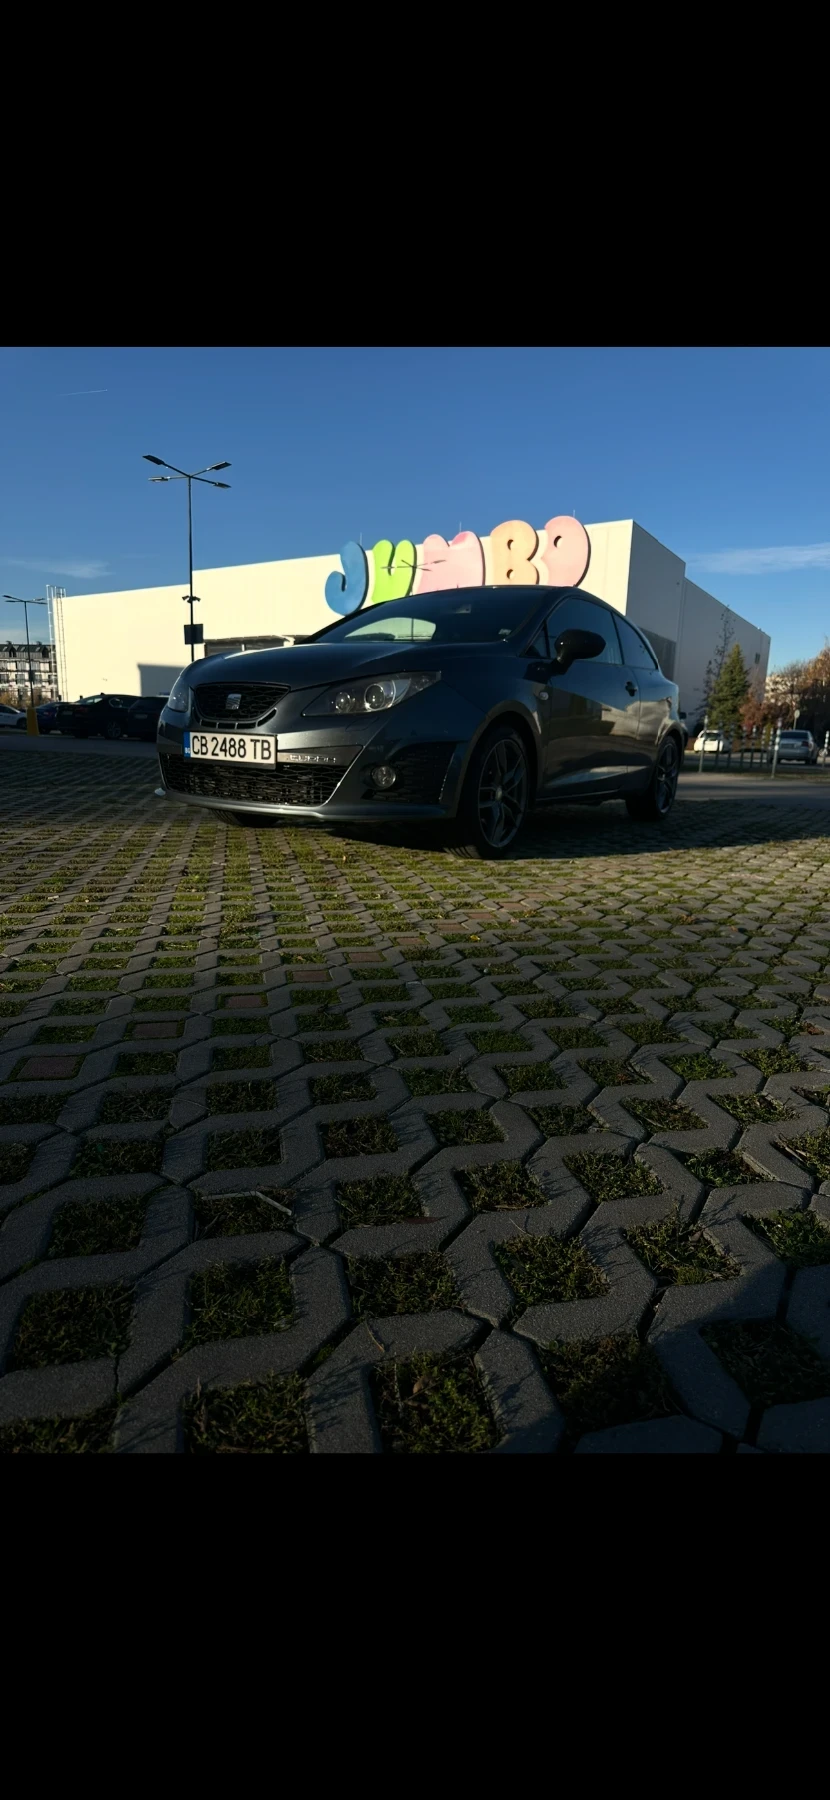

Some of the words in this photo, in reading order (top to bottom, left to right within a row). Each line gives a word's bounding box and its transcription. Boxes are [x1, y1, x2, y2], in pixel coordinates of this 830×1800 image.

[192, 735, 208, 756] CB
[211, 737, 247, 758] 2488
[250, 738, 271, 760] TB
